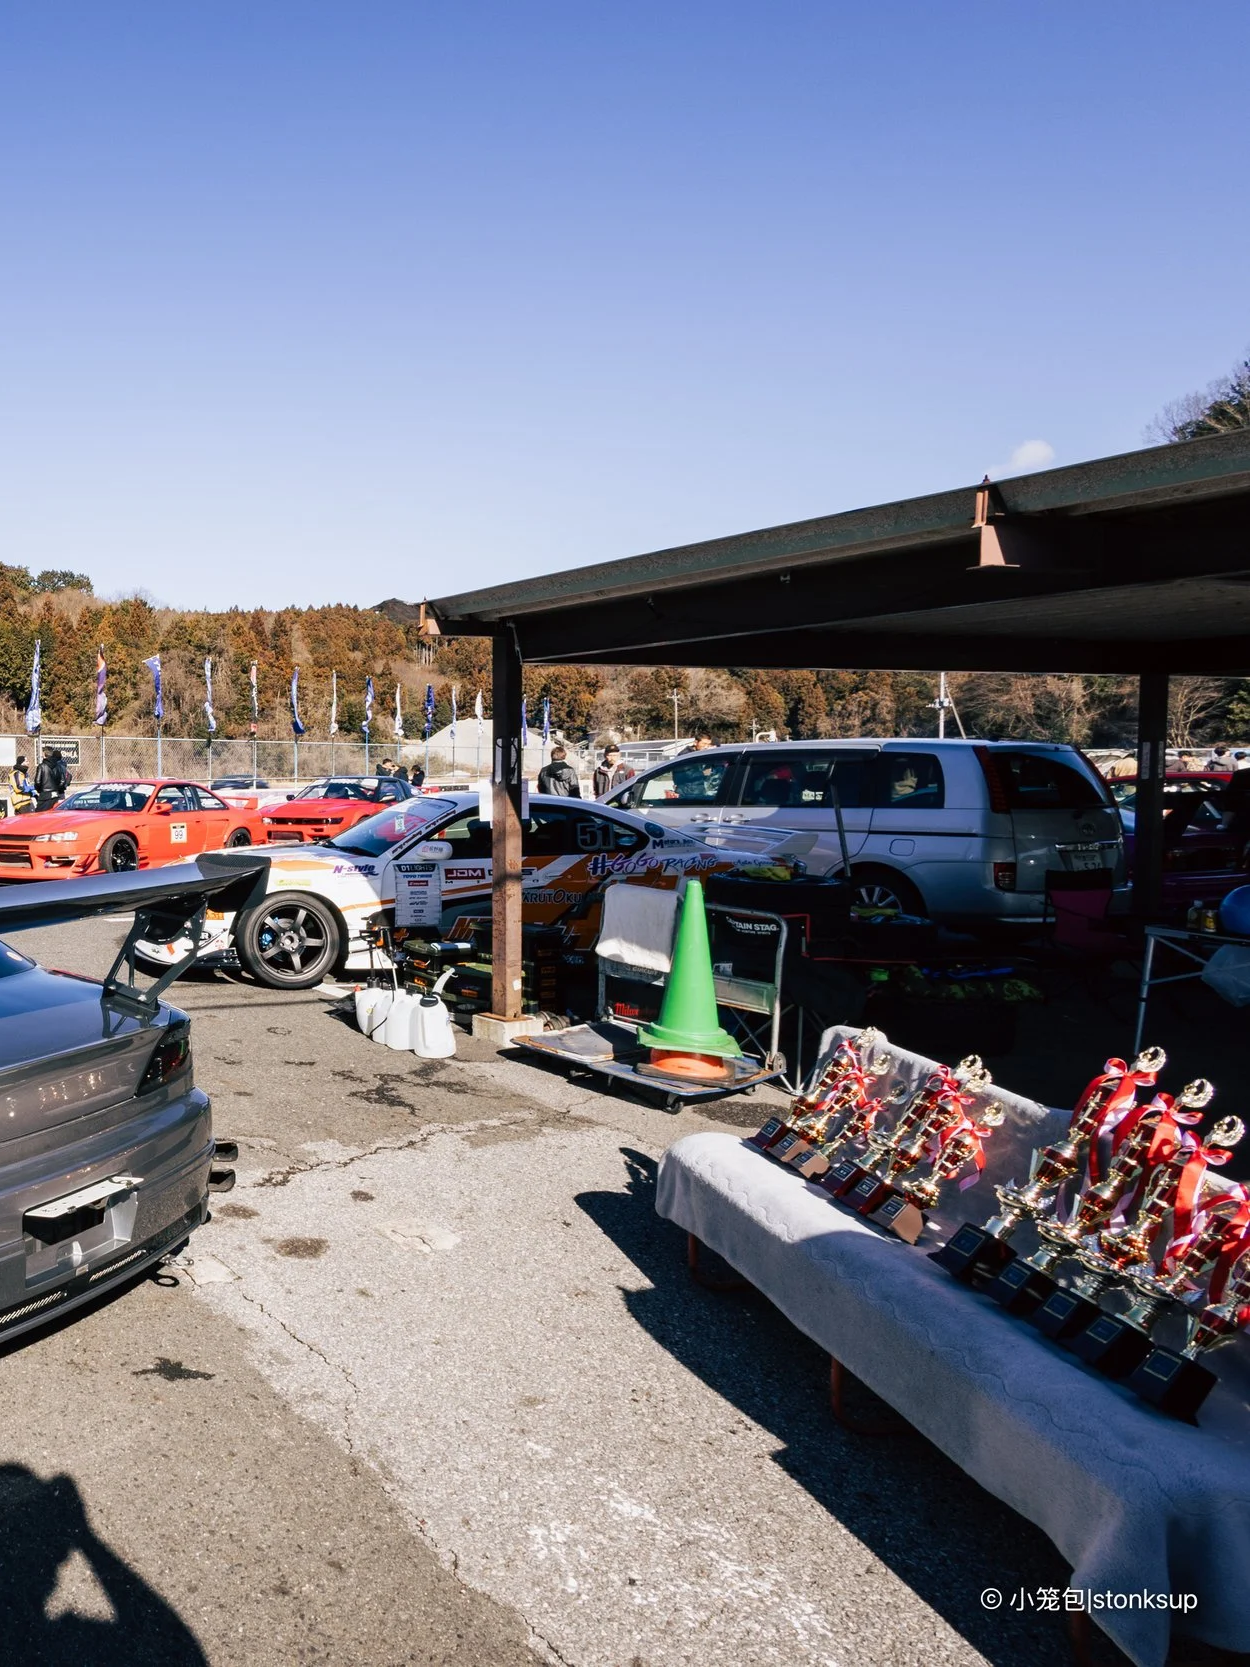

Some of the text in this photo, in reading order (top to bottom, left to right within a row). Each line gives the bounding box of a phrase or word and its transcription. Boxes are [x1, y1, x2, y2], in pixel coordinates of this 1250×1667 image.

[174, 829, 184, 840] 99
[577, 821, 614, 850] 51
[446, 869, 483, 878] JDM
